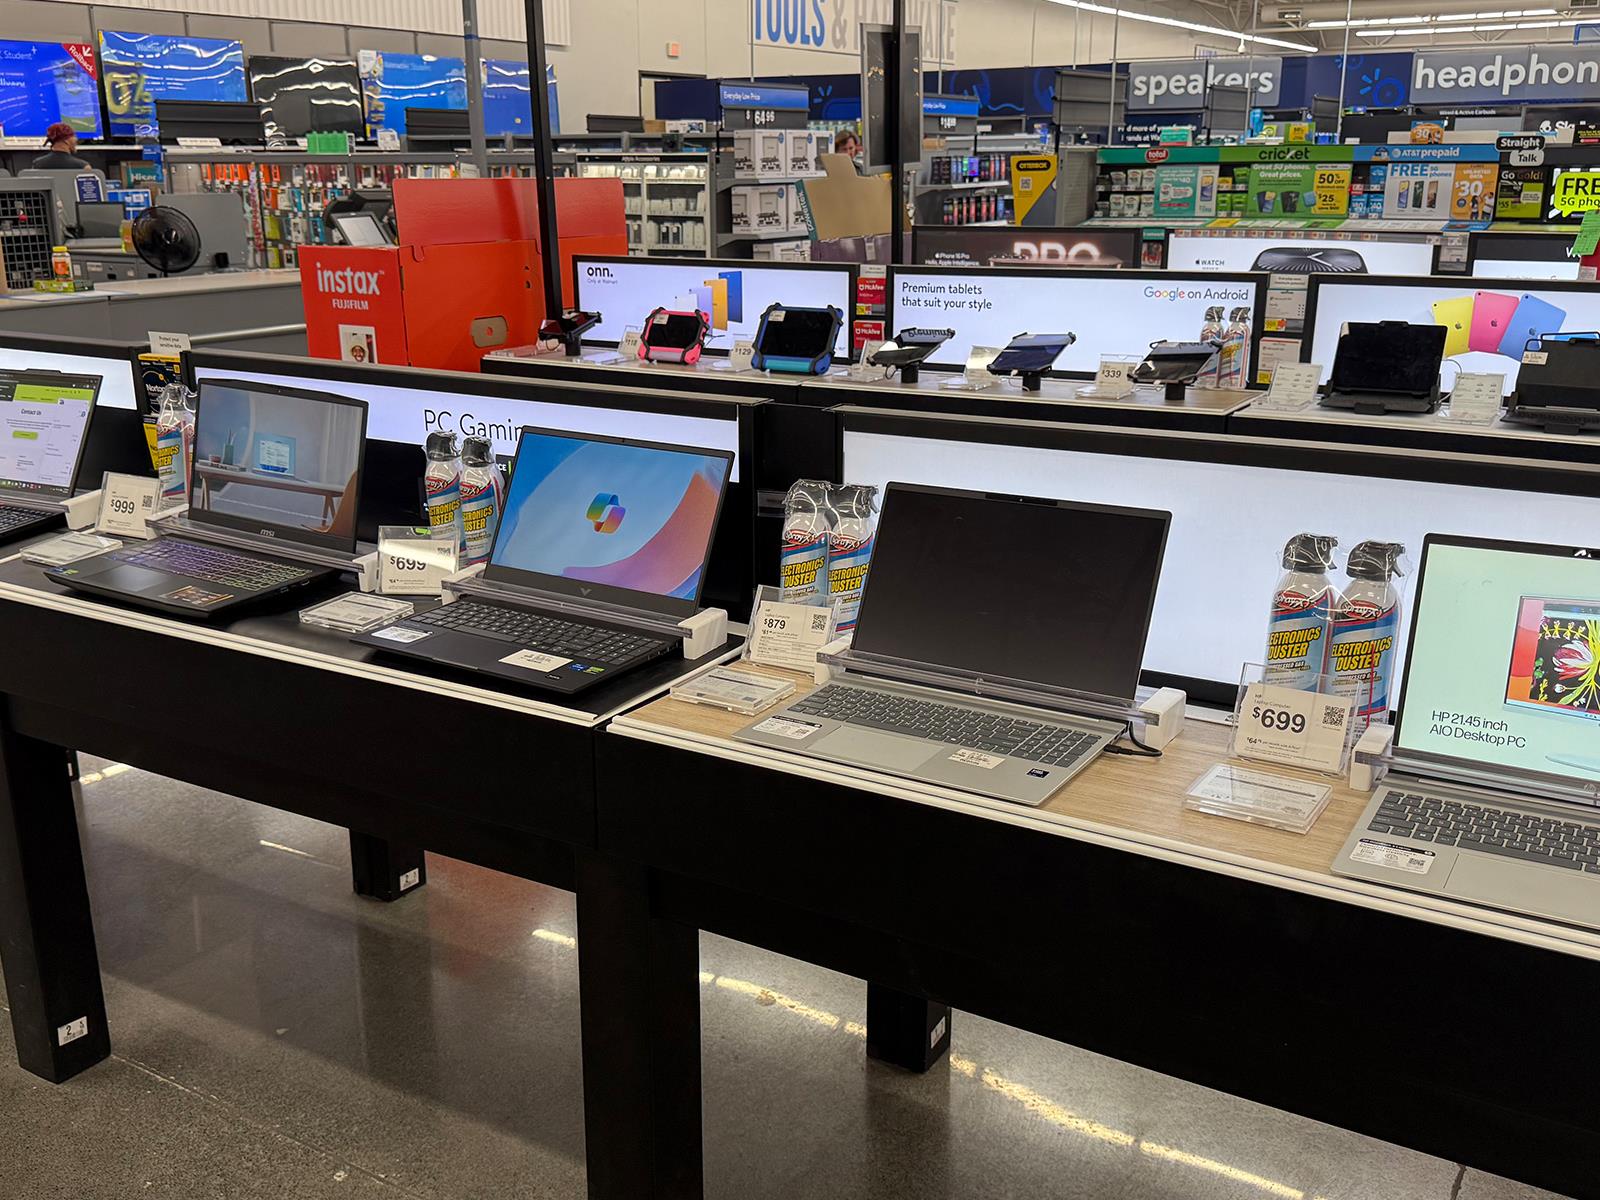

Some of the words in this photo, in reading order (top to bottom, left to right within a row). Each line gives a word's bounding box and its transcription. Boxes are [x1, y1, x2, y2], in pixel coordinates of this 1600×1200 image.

[831, 0, 848, 49] &
[69, 45, 93, 72] Rollback
[1500, 137, 1540, 149] Straight
[1258, 147, 1310, 160] cricket
[1421, 147, 1460, 159] prepaid
[1518, 154, 1538, 163] Talk
[1391, 163, 1430, 177] FREE
[1501, 170, 1515, 180] Go
[1560, 197, 1575, 206] 5G
[316, 261, 380, 296] instax
[587, 266, 614, 278] onn.
[902, 281, 946, 295] Premium
[949, 283, 983, 295] tablets
[1145, 286, 1185, 301] Google
[1187, 290, 1202, 299] on
[1203, 288, 1249, 300] Android
[332, 298, 369, 311] FUJIFILM
[902, 296, 921, 308] that
[923, 297, 942, 309] suit
[944, 300, 966, 311] your
[968, 299, 992, 312] style
[1102, 369, 1122, 379] $339
[145, 384, 166, 393] Norto
[424, 409, 452, 432] PC
[110, 499, 135, 514] $999
[260, 529, 275, 537] msi
[764, 618, 786, 630] $879
[1332, 636, 1393, 658] ELECTRONICS
[1335, 653, 1381, 671] DUSTER
[1252, 706, 1306, 734] $699
[1431, 710, 1450, 722] HP
[1451, 713, 1481, 728] 21.45
[1482, 718, 1508, 732] inch
[1429, 723, 1453, 737] AIO
[1454, 727, 1505, 747] Desktop
[1506, 735, 1527, 748] PC
